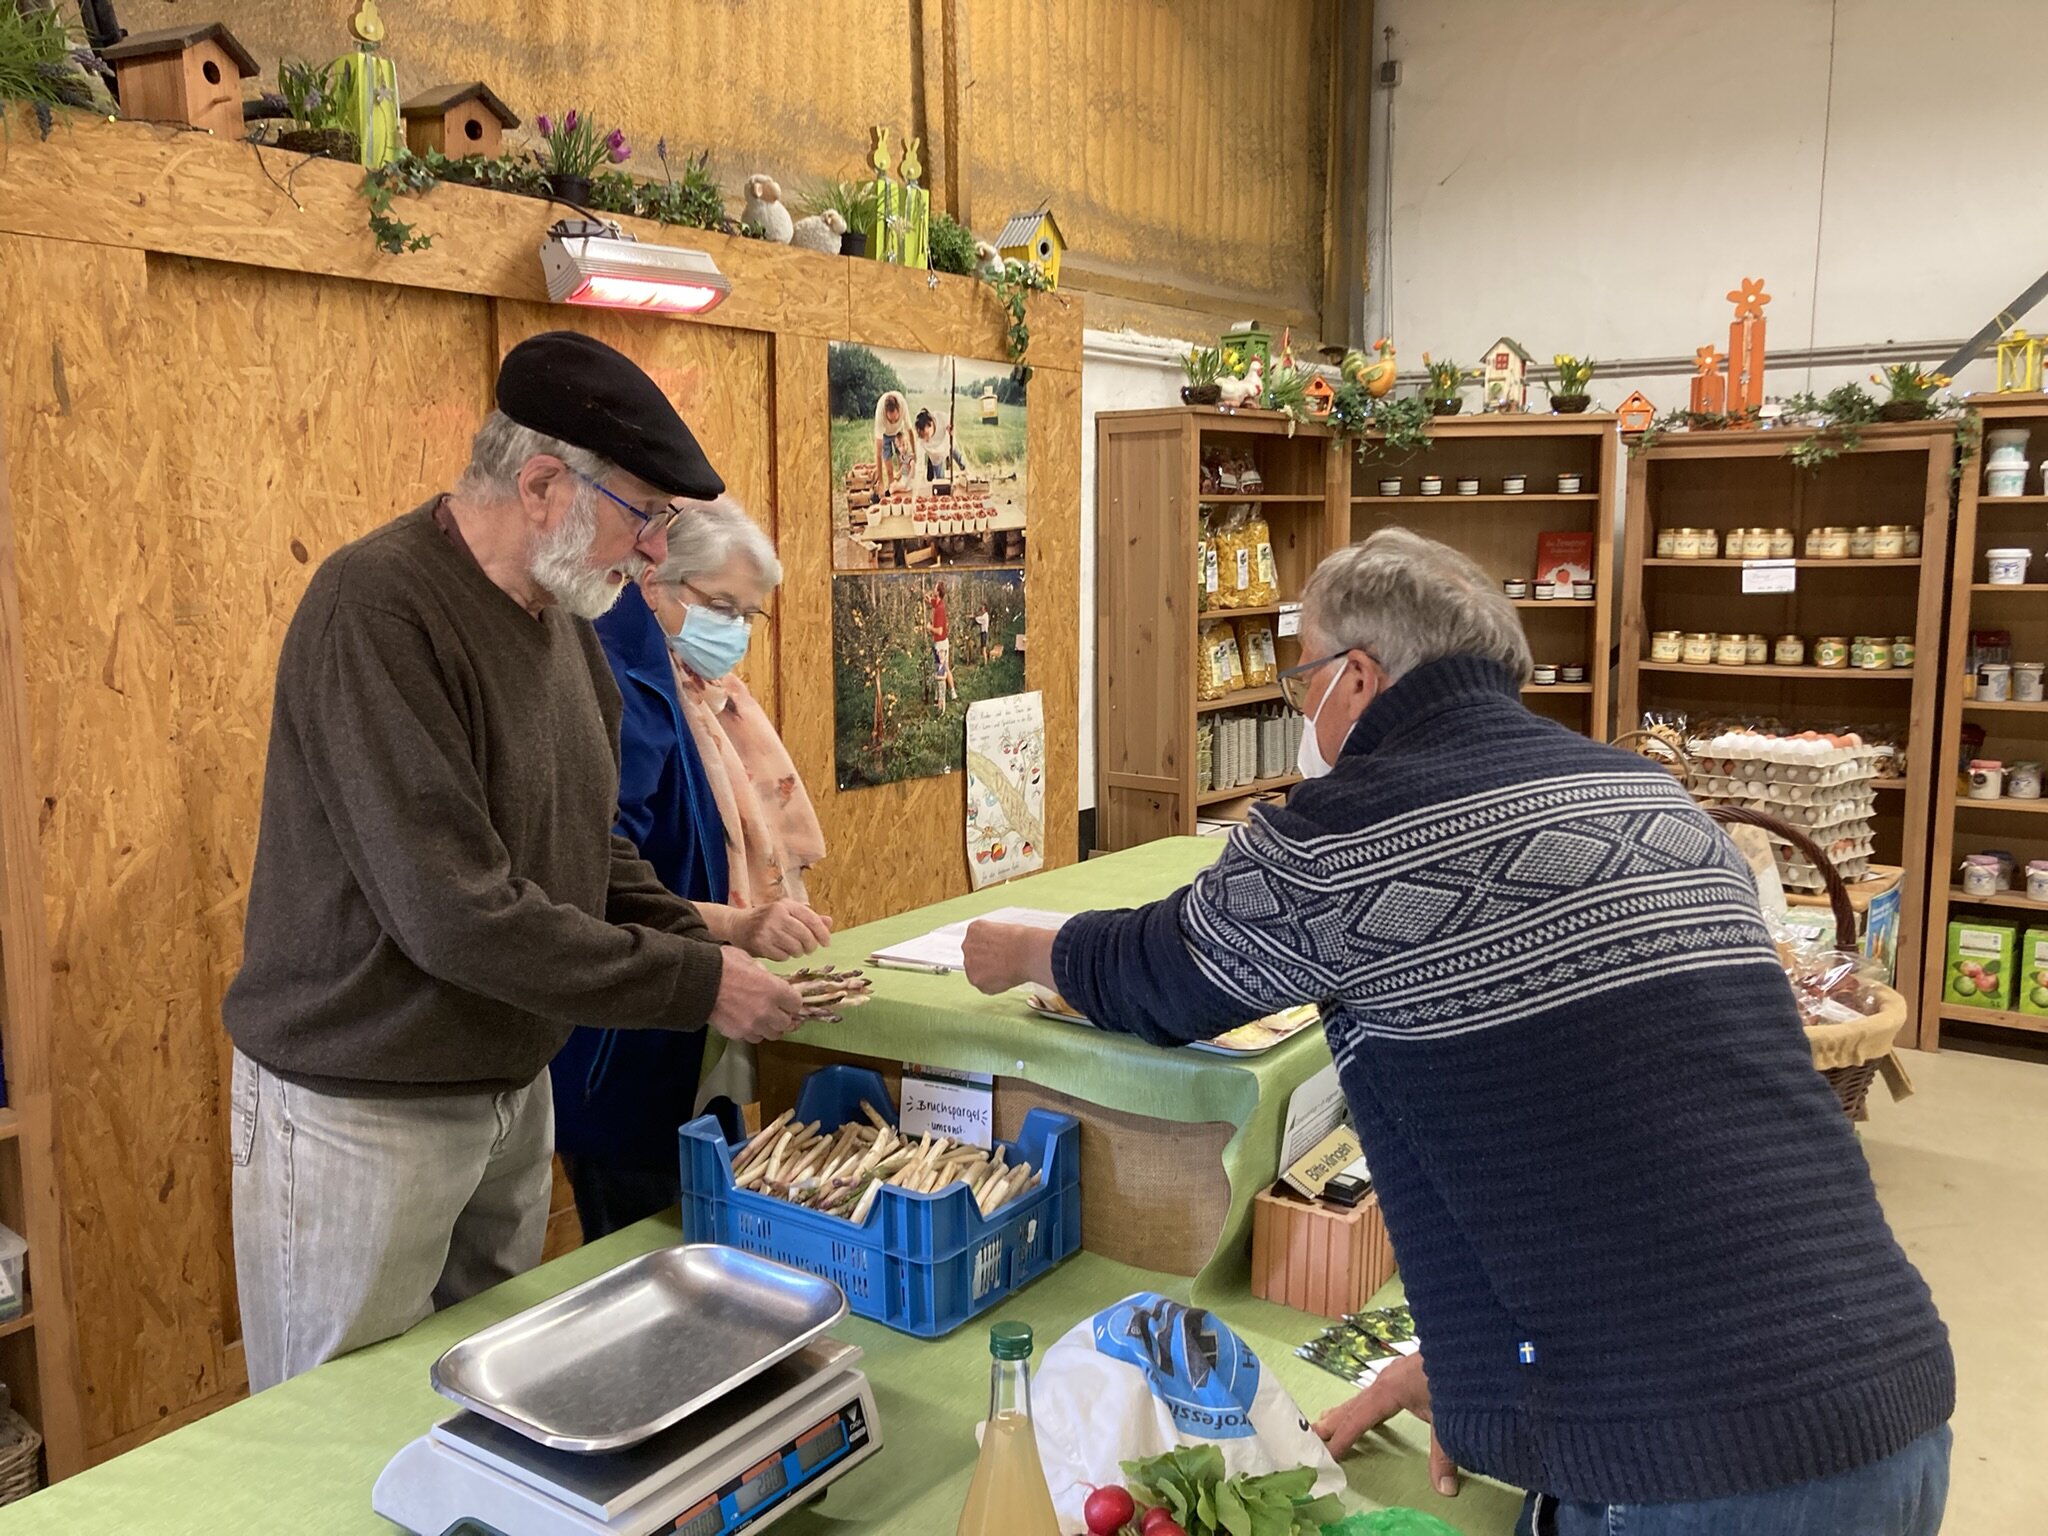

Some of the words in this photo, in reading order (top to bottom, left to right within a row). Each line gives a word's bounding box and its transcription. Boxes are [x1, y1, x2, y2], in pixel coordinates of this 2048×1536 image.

[917, 1100, 980, 1123] Bruchspargel
[1305, 1163, 1330, 1181] Bitte
[1323, 1142, 1353, 1167] klingeln
